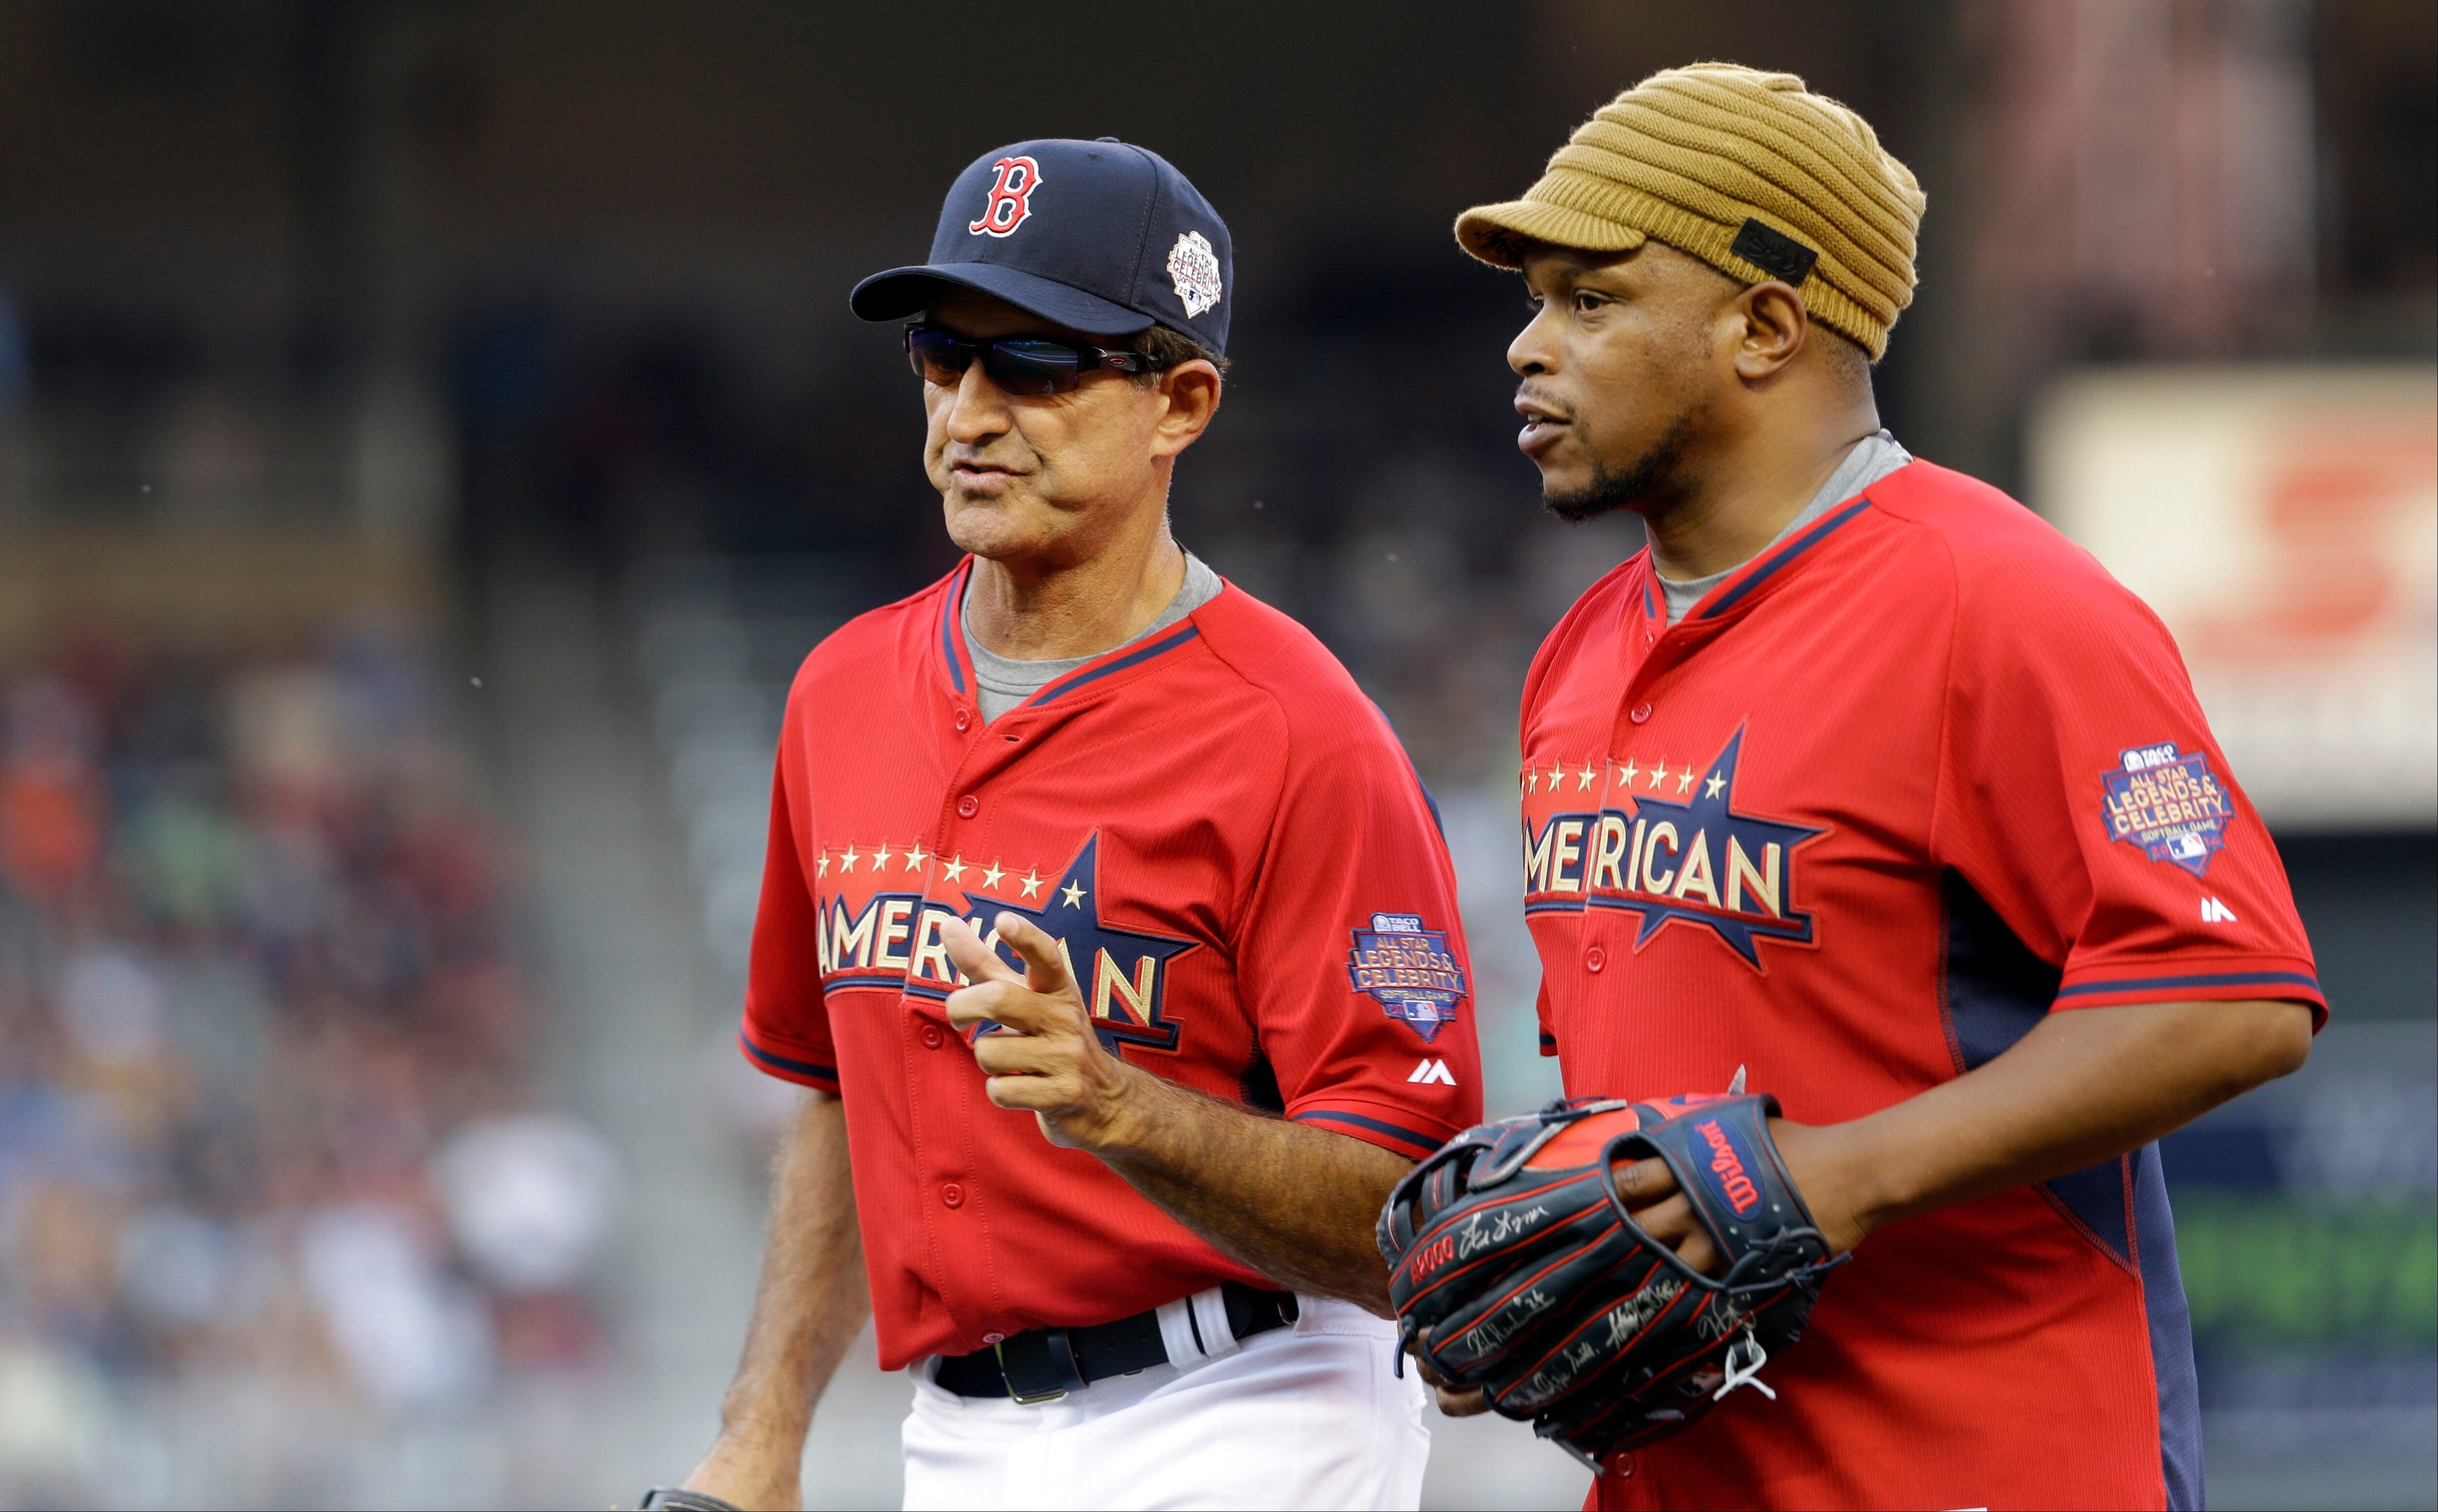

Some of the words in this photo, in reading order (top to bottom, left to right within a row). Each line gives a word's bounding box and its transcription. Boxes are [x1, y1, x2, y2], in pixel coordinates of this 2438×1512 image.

[969, 156, 1043, 237] B
[1173, 260, 1219, 296] CELEBRITY
[1174, 247, 1213, 279] LEGENDS
[2106, 777, 2202, 815] LEGENDS
[2202, 775, 2218, 796] &
[2114, 795, 2223, 835] CELEBRITY
[2141, 825, 2189, 843] SOFTBALL
[2189, 819, 2217, 832] GAME
[1522, 817, 1781, 919] MERICAN
[1392, 924, 1422, 932] BELL
[817, 900, 1155, 1027] AMERN
[1353, 950, 1440, 969] LEGENDS
[1440, 952, 1454, 972] &
[1357, 969, 1458, 990] CELEBRITY
[1380, 989, 1426, 1000] SOFTBALL
[1426, 991, 1451, 1002] GAME
[1694, 1120, 1759, 1214] Wilson
[1409, 1234, 1455, 1288] A2000
